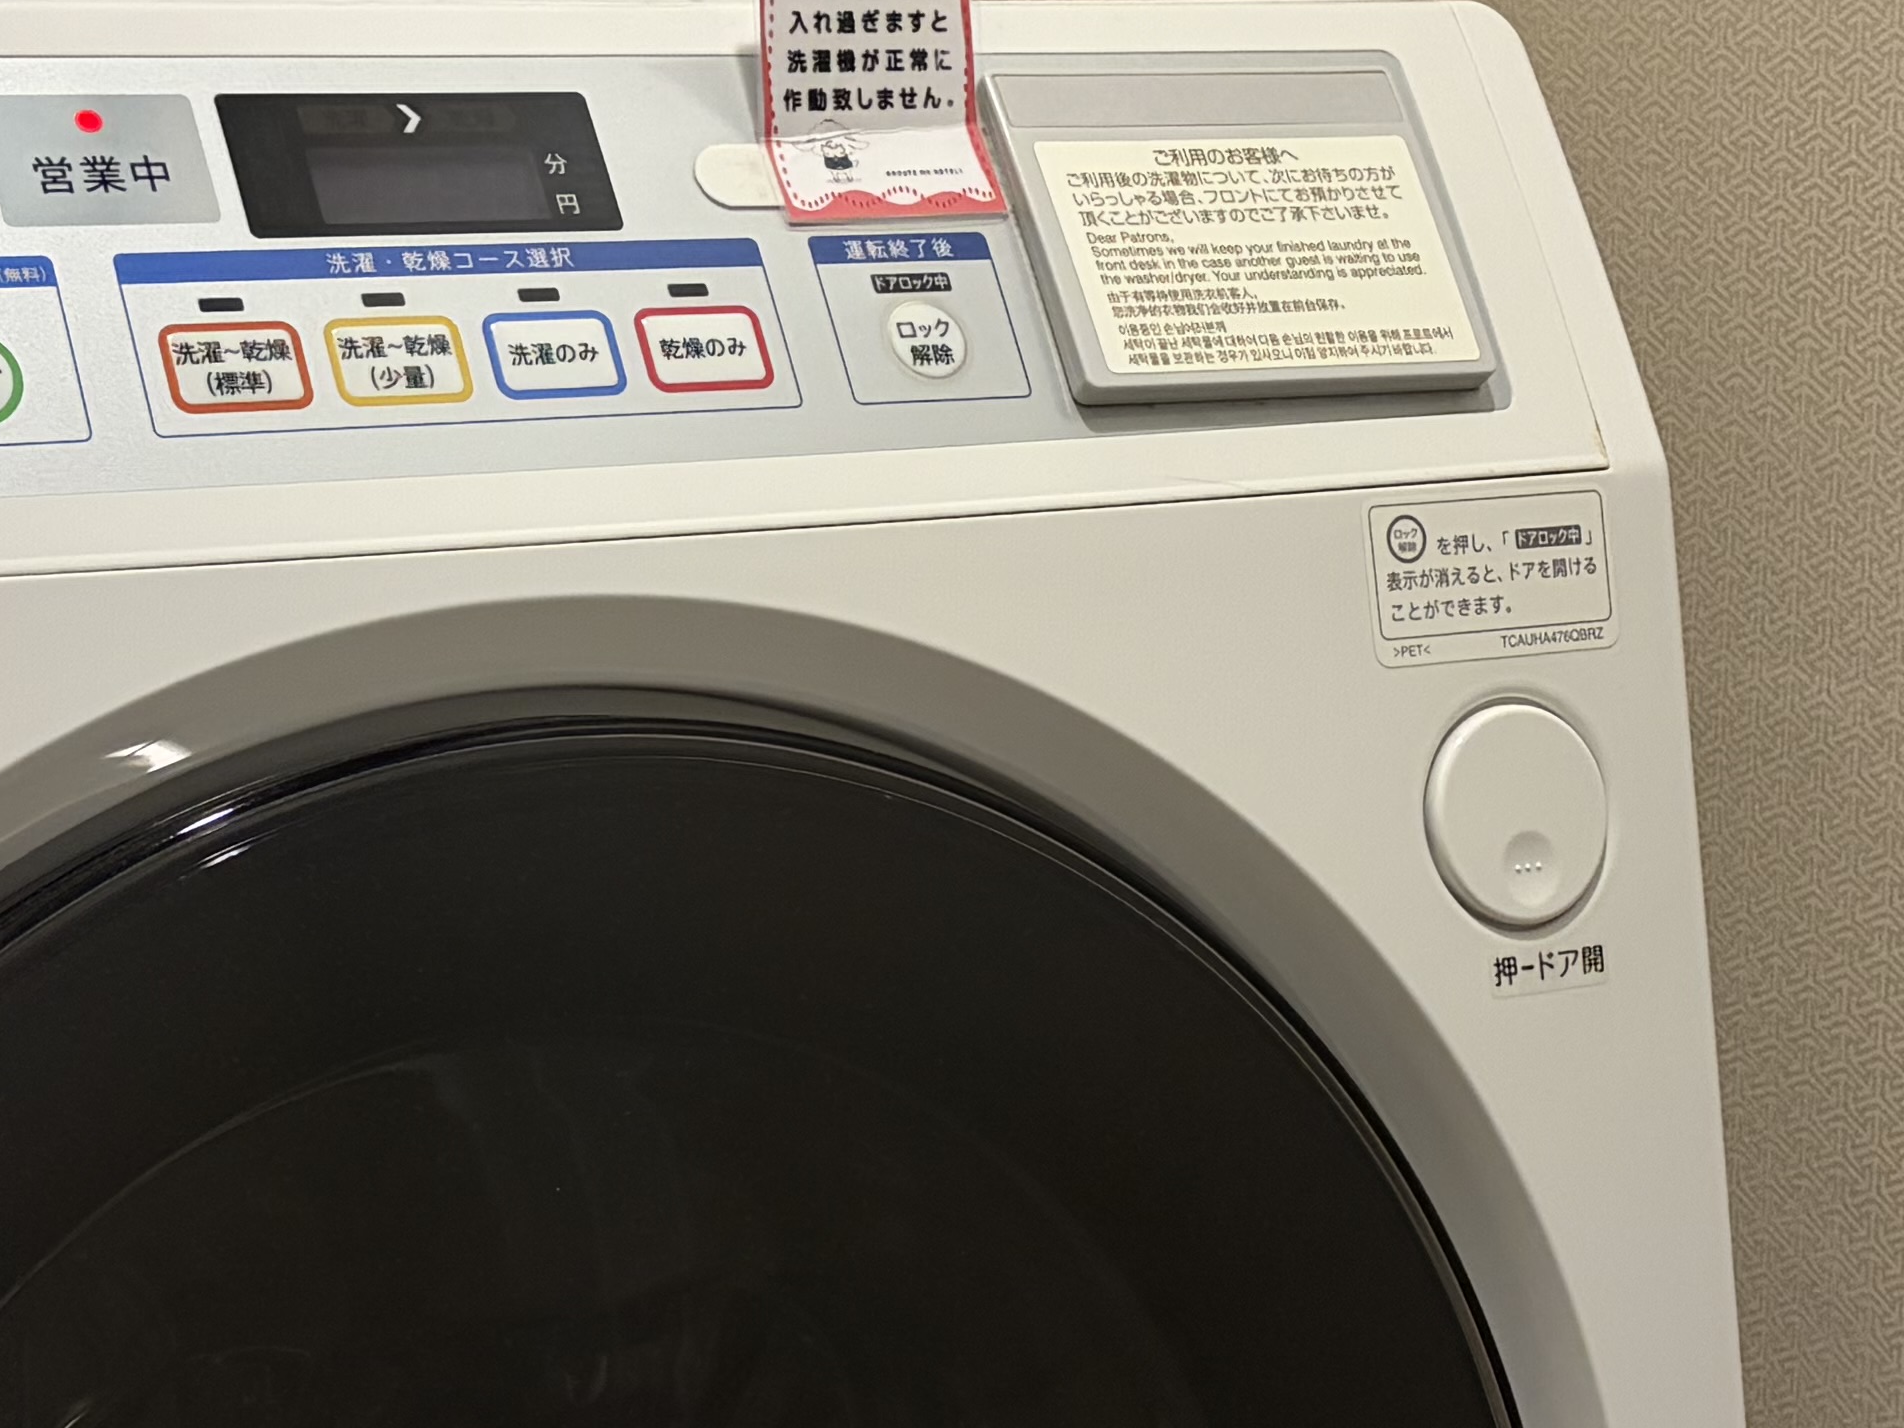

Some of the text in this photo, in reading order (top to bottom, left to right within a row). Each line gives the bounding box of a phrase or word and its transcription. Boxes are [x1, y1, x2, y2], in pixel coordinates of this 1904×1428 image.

[788, 9, 949, 35] 入れ過ぎますと
[786, 47, 954, 74] 洗濯機が正常に
[782, 86, 956, 113] 作動致しません。
[544, 152, 569, 176] 分
[1152, 146, 1299, 167] ご利用のお客様へ
[32, 154, 171, 196] 営業中
[1066, 165, 1396, 189] ご利用後の洗濯物について、次にお待ちの方が
[555, 194, 581, 216] 円
[1072, 184, 1403, 207] いらっしゃる場合、フロントにてお預かりさせて
[842, 237, 955, 261] 運転終了後
[1086, 230, 1175, 244] Dear Patrons,
[1091, 237, 1411, 258] Sometimes we will keep your finished laundry at the
[1095, 259, 1126, 271] front
[1129, 258, 1160, 271] desk
[1163, 258, 1175, 269] in
[1178, 257, 1198, 269] the
[1201, 258, 1232, 268] case
[1234, 254, 1281, 267] another
[1285, 254, 1320, 268] guest
[1336, 251, 1380, 266] waiting
[1383, 251, 1396, 263] to
[1398, 251, 1420, 262] use
[872, 273, 950, 292] ドアロック中
[1100, 272, 1122, 285] the
[1124, 270, 1210, 286] washer/dryer.
[1213, 270, 1241, 282] Your
[1244, 267, 1335, 281] understanding
[1350, 264, 1427, 280] appreciated.
[897, 318, 950, 340] ロック
[507, 341, 600, 367] 洗濯のみ
[658, 335, 748, 362] 乾燥のみ
[909, 343, 956, 365] 解除
[206, 369, 273, 397] (標準)
[370, 363, 436, 391] (少量)
[1386, 556, 1598, 592] 表示が消えると、ドアを開ける
[1391, 594, 1514, 622] ことができます。
